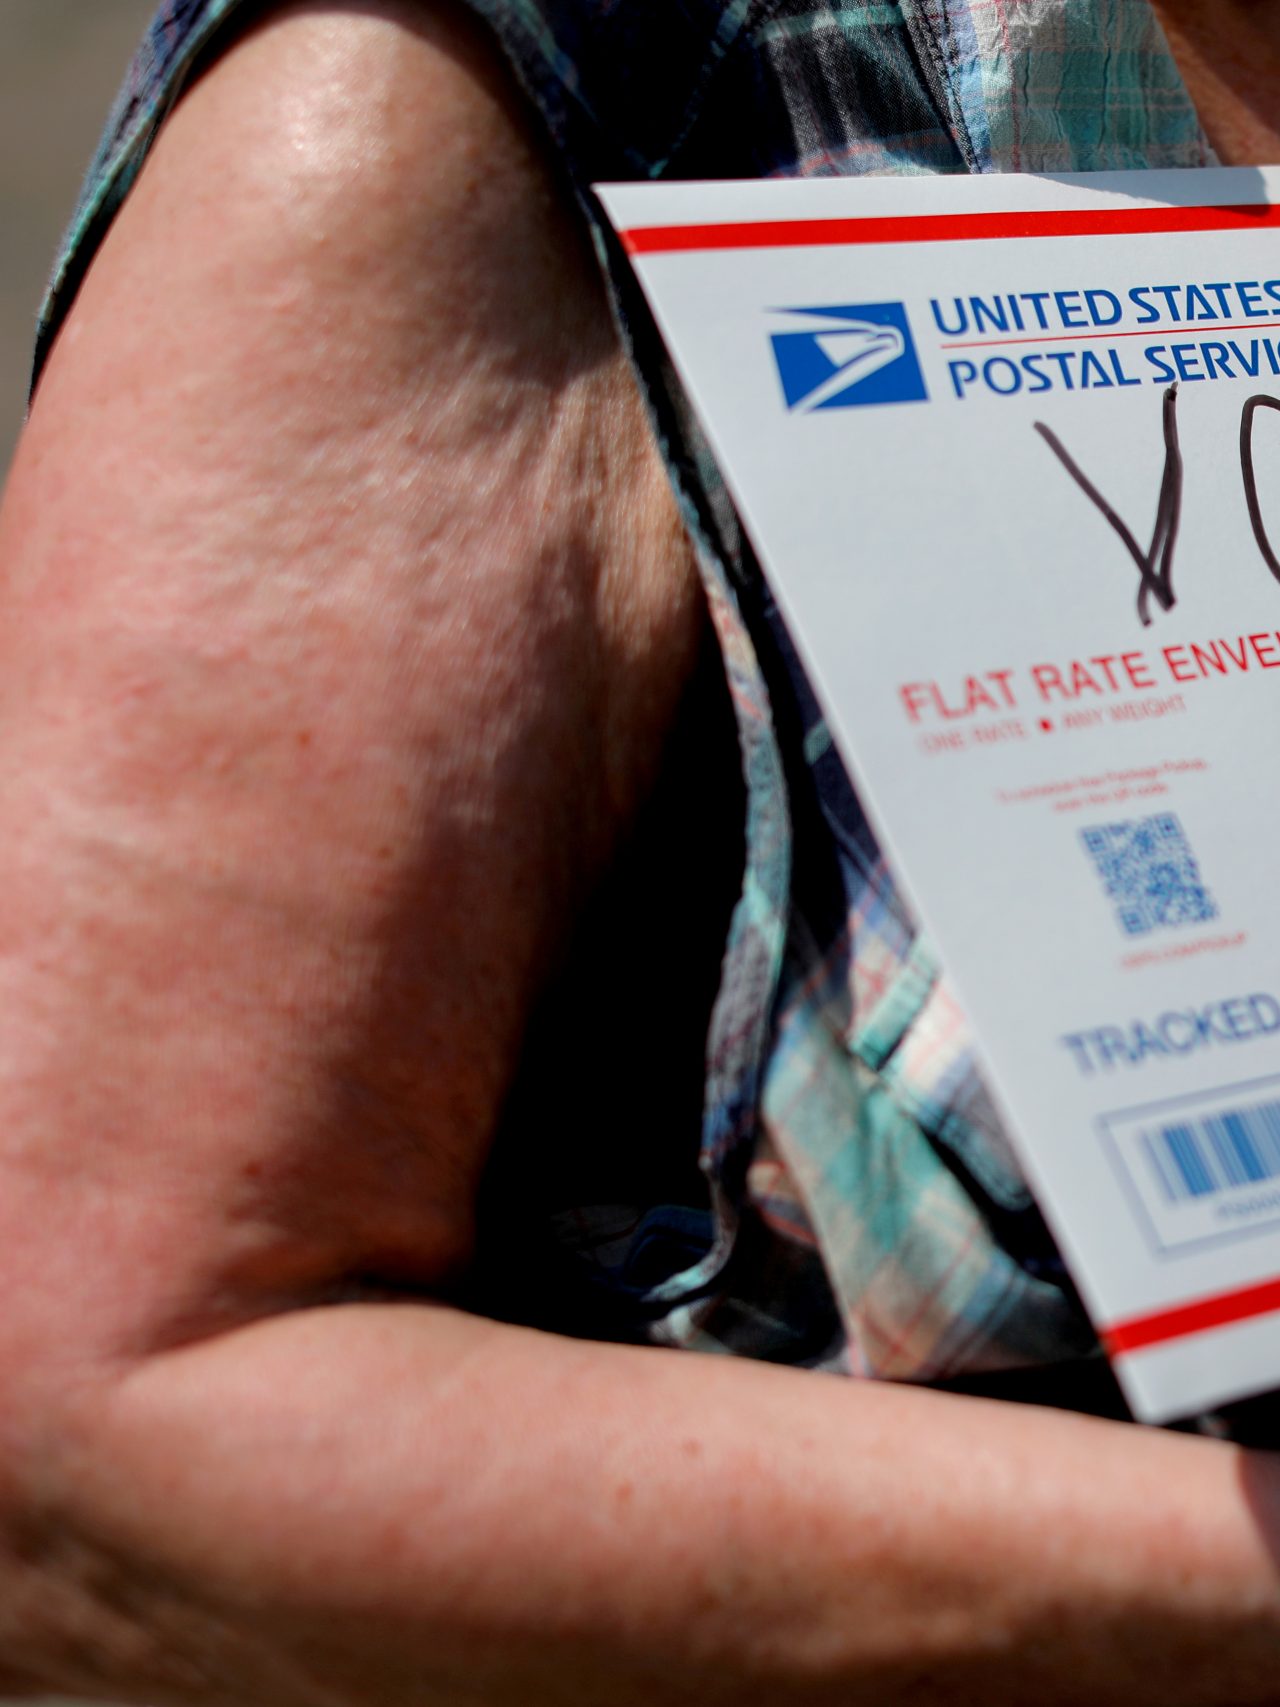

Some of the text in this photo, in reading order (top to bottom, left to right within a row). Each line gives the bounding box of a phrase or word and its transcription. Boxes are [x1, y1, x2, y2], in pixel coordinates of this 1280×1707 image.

[930, 288, 1122, 336] UNITED
[948, 348, 1141, 400] POSTAL
[900, 670, 1018, 724] FLAT
[1030, 651, 1156, 700] RATE
